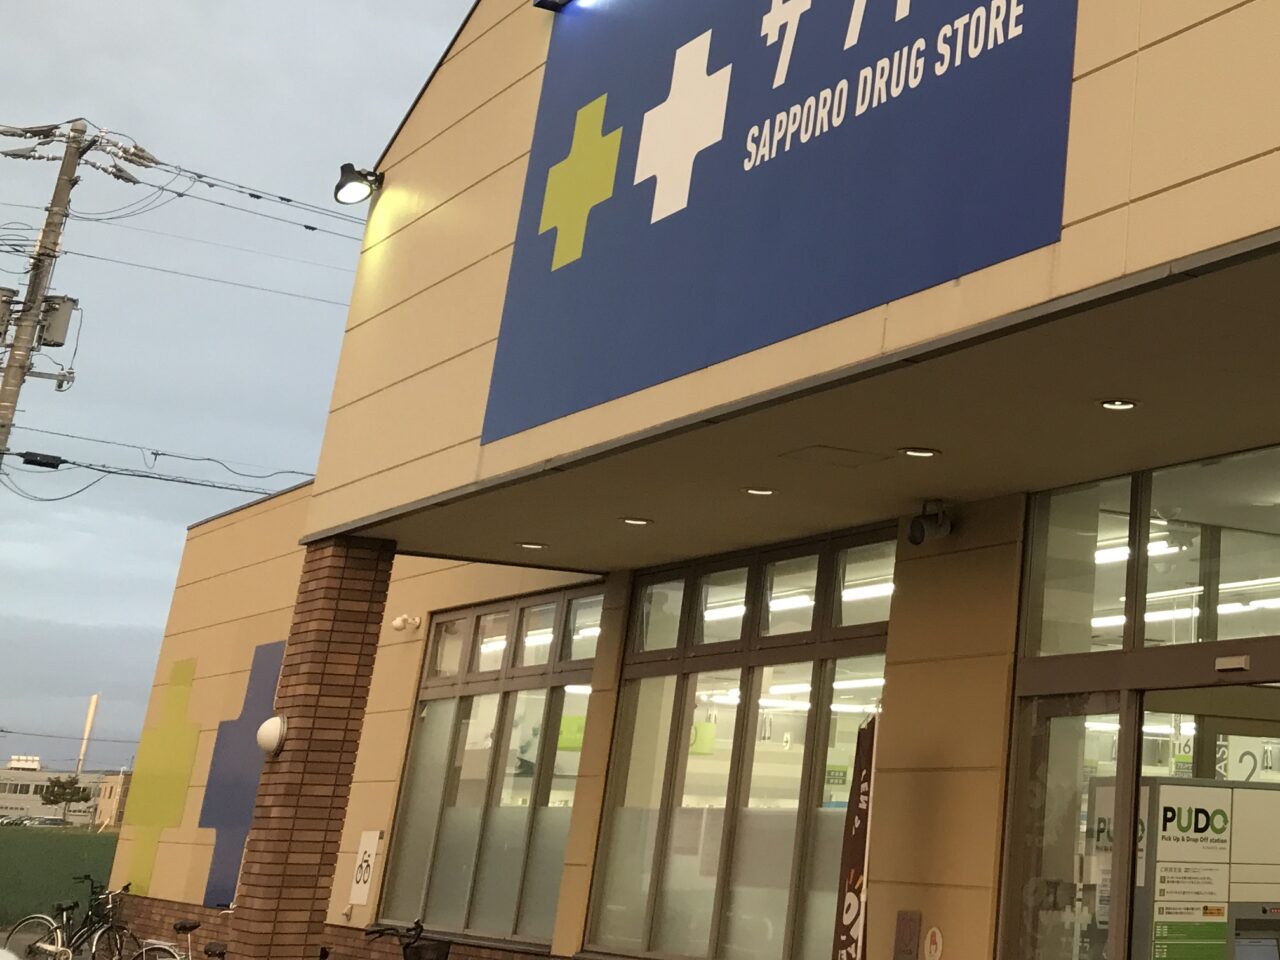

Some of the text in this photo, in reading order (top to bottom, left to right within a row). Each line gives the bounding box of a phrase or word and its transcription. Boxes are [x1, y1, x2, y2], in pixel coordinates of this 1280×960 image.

[743, 79, 848, 171] SAPPORO
[855, 38, 925, 117] DRUG
[1162, 806, 1229, 835] PUDO
